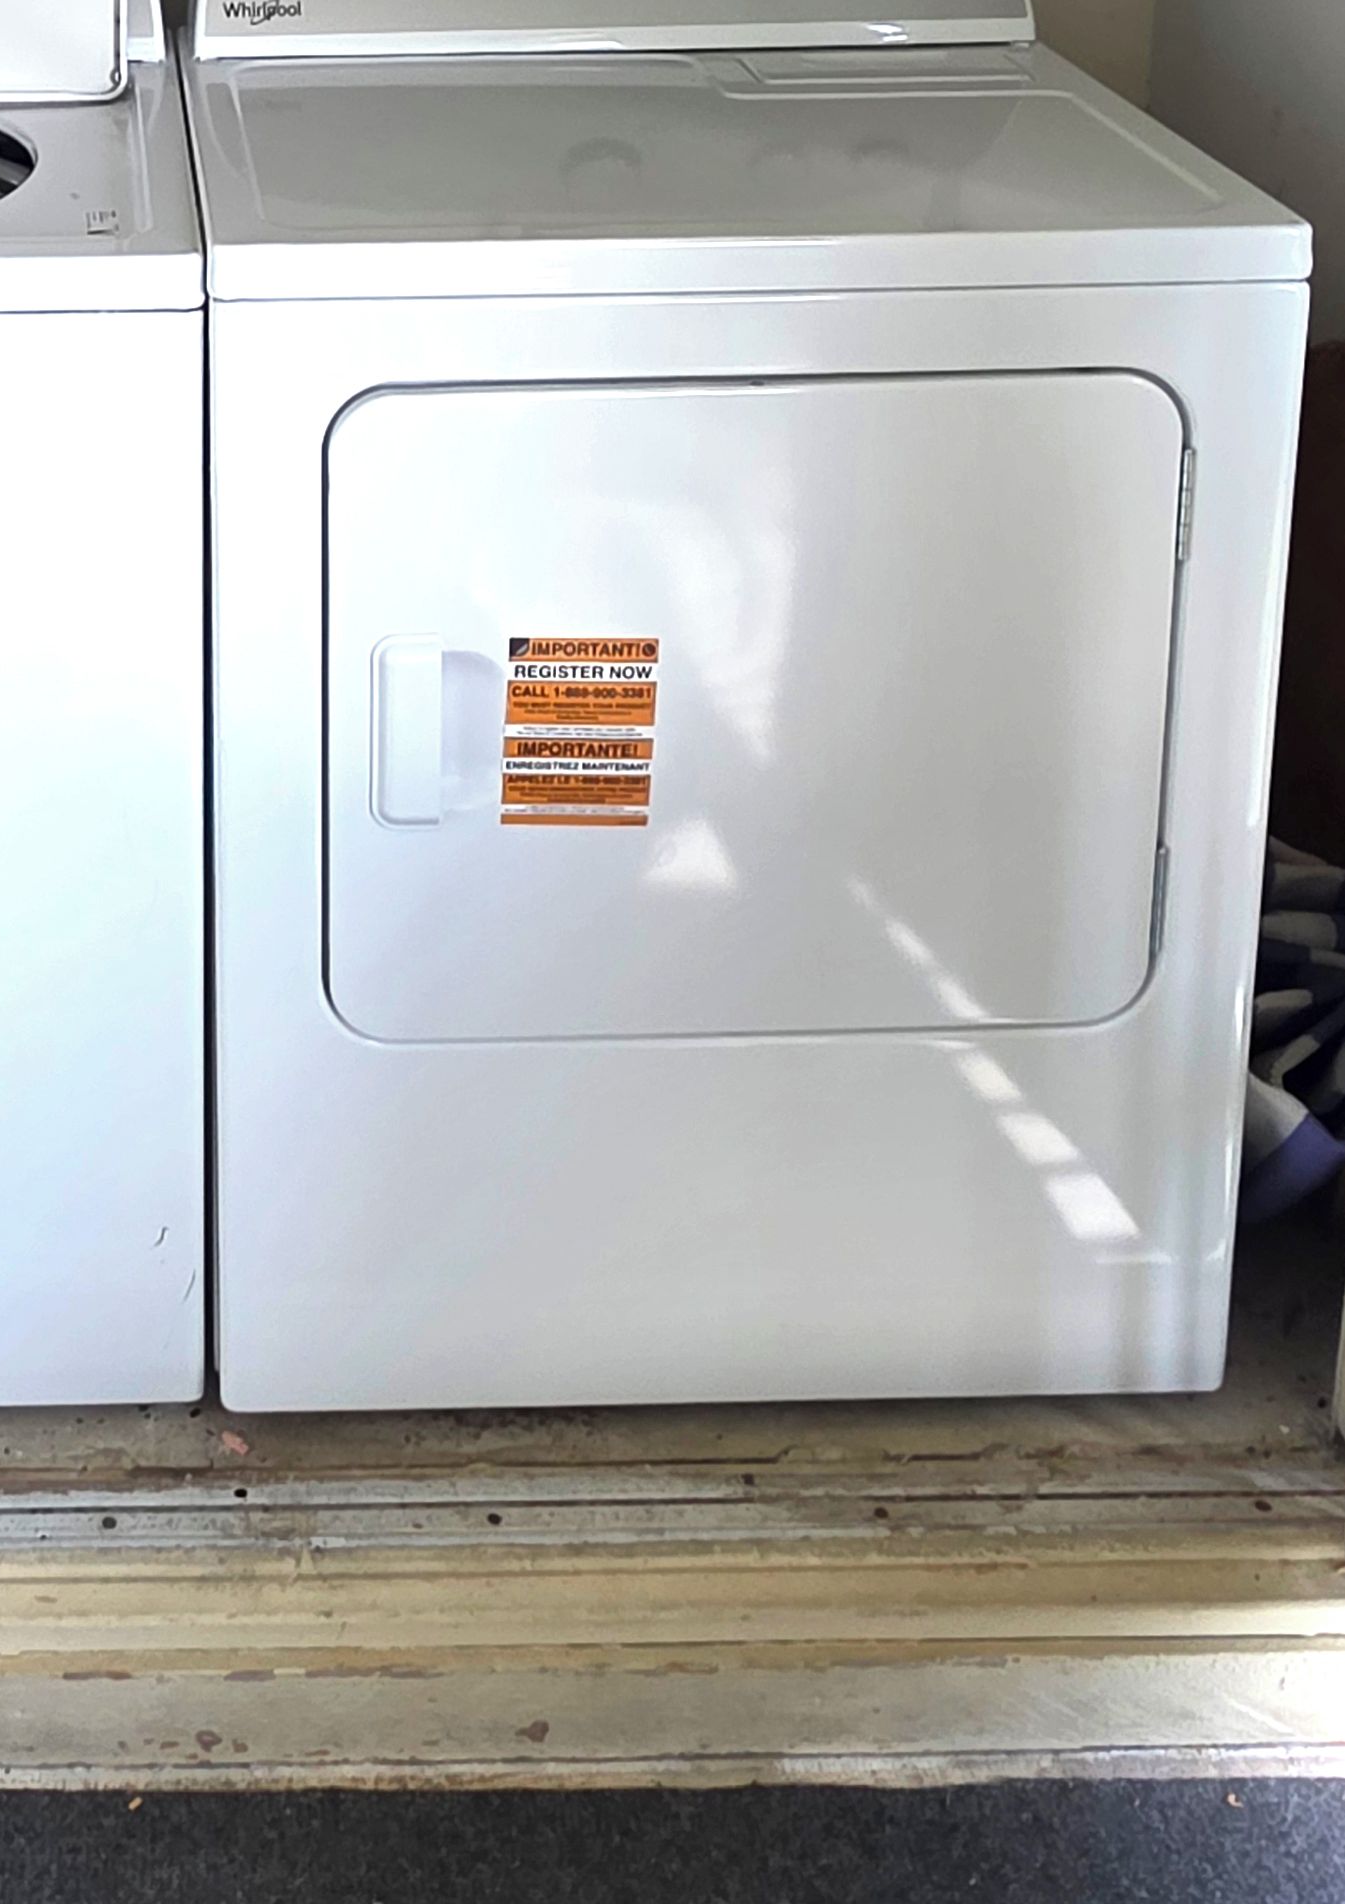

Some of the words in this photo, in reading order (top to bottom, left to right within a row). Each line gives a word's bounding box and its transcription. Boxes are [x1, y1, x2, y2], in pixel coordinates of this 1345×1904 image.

[531, 642, 641, 657] IMPORTANT!
[514, 664, 604, 679] REGISTER
[609, 665, 653, 679] NOW
[511, 685, 549, 698] CALL
[517, 741, 638, 757] IMPORTANTE!
